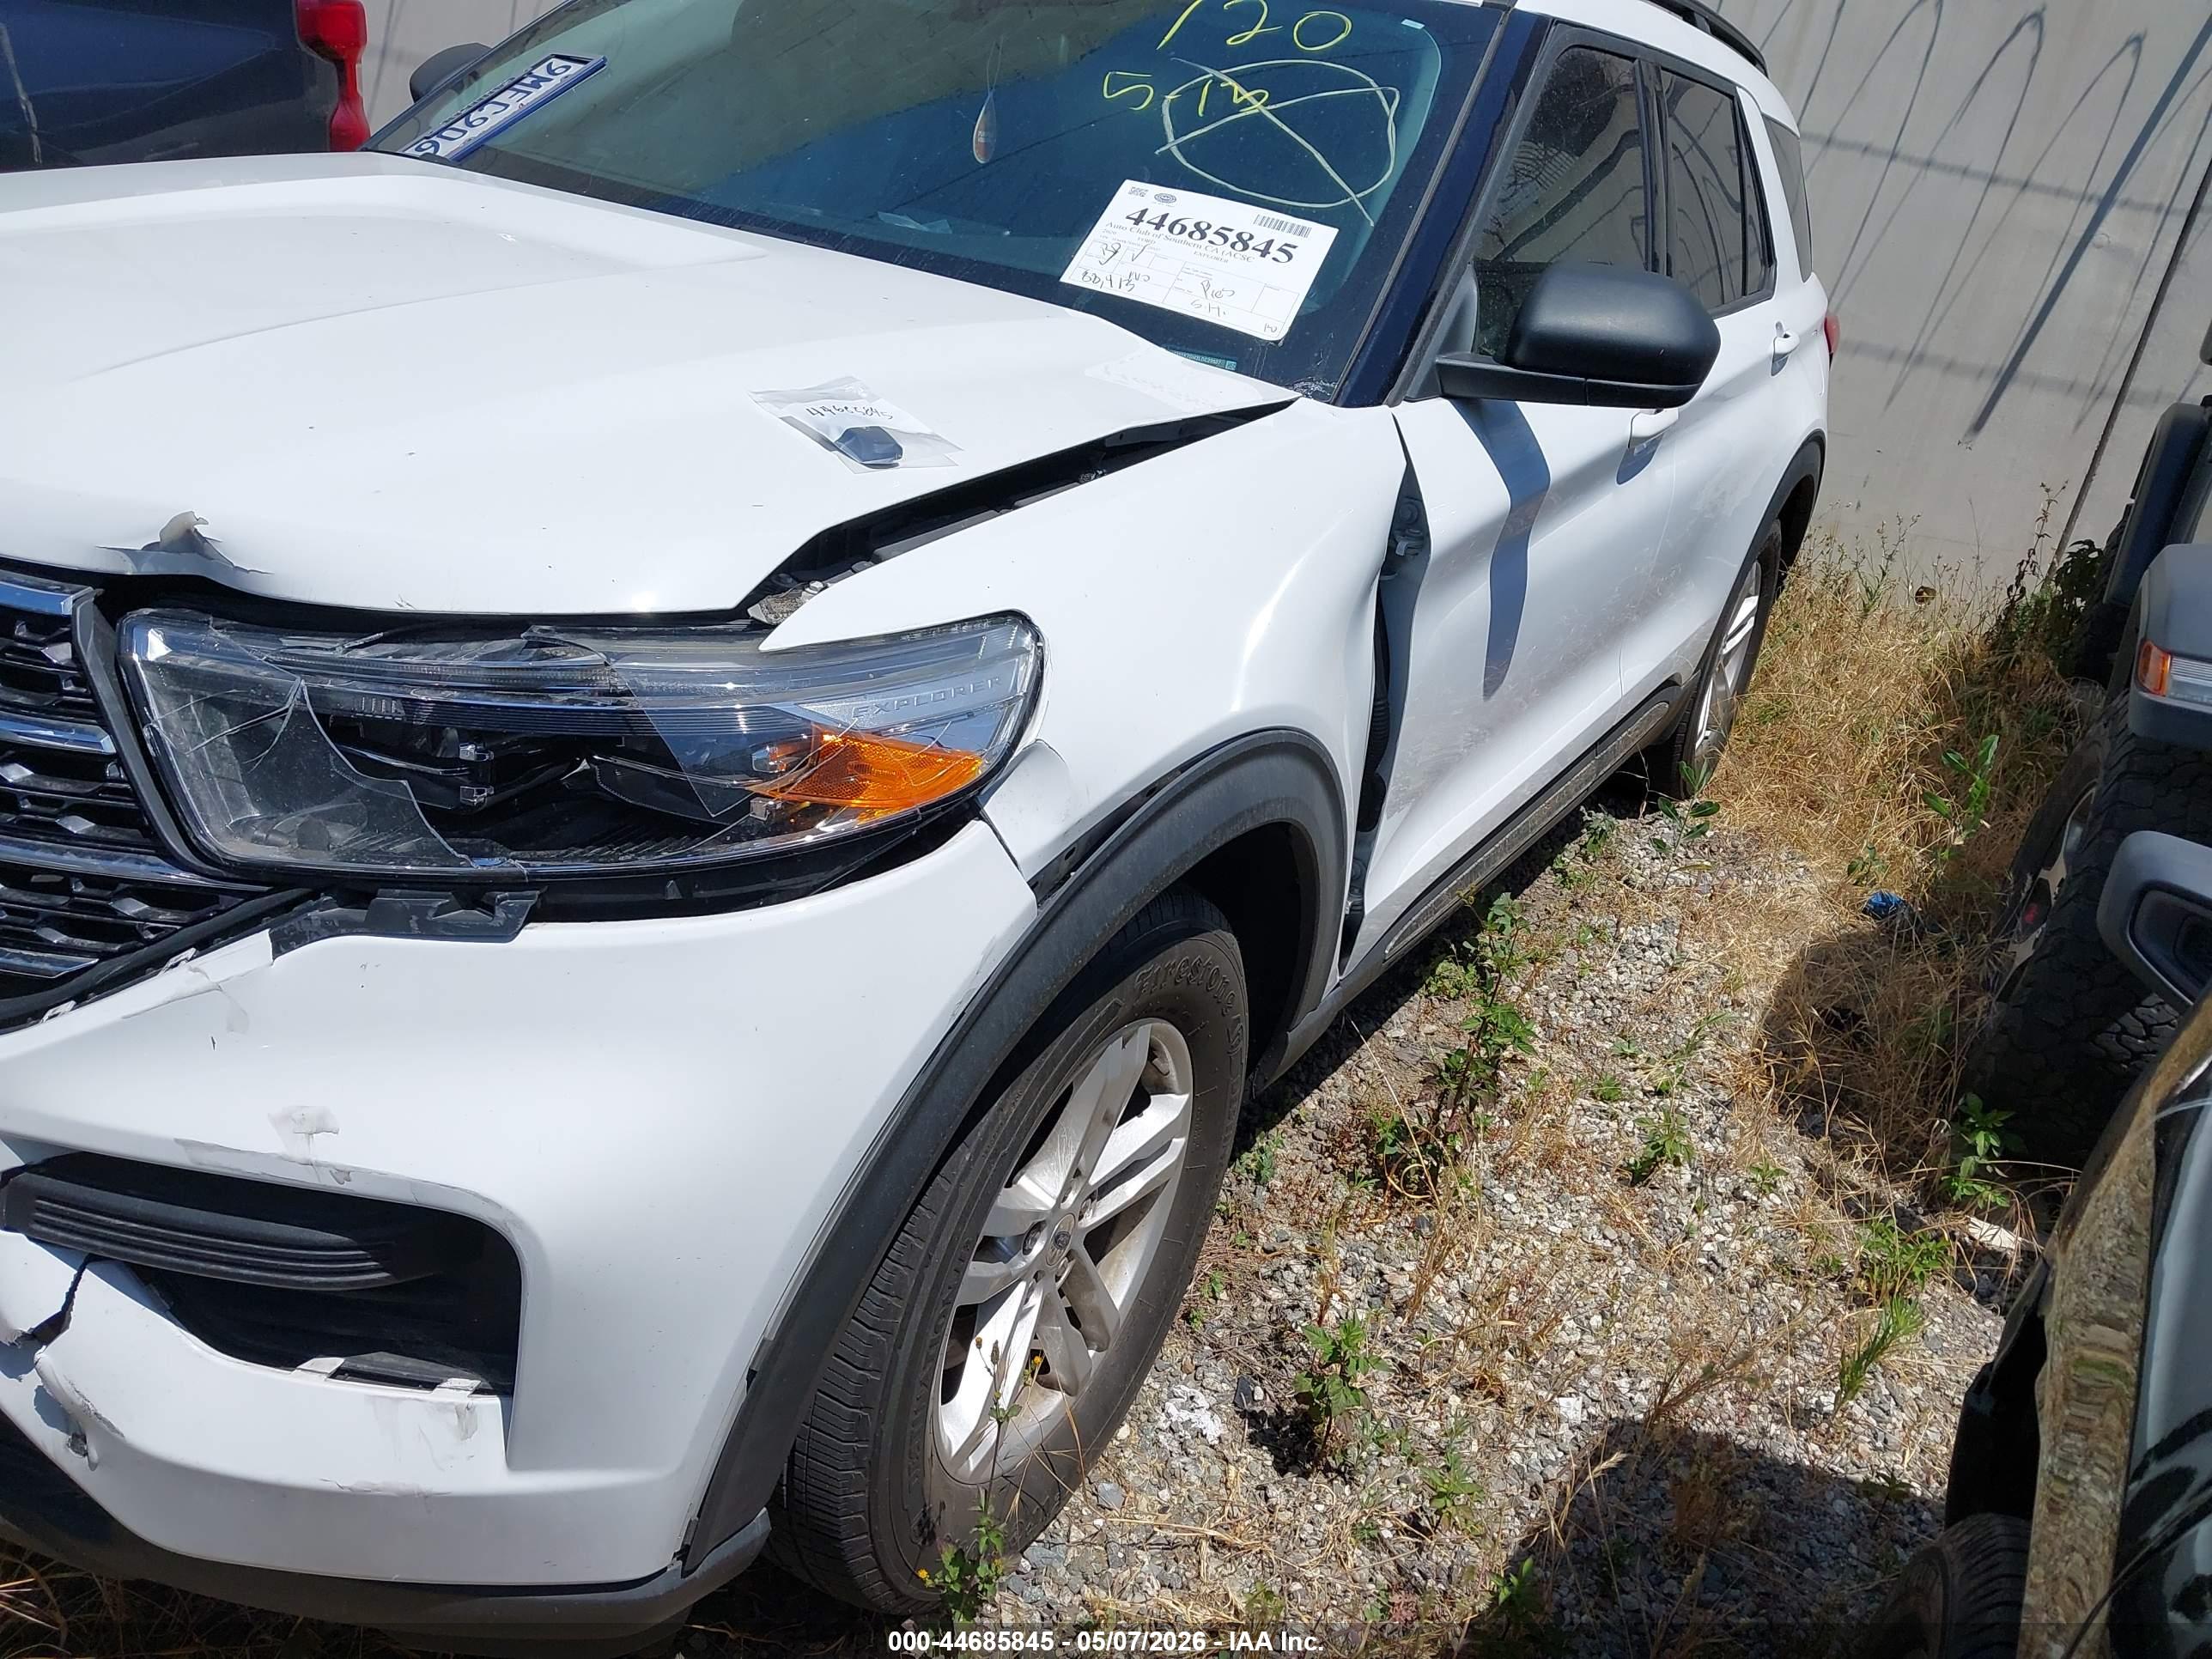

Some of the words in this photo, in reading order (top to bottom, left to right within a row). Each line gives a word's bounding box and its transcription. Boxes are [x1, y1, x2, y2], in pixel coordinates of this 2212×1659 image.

[1105, 222, 1127, 231] Auto
[1129, 226, 1151, 237] Club
[1163, 234, 1202, 250] Southern
[1204, 245, 1218, 254] CA
[1125, 208, 1299, 264] 44685845
[852, 676, 1002, 720] EXPLORER
[1134, 954, 1237, 1017] Firestone
